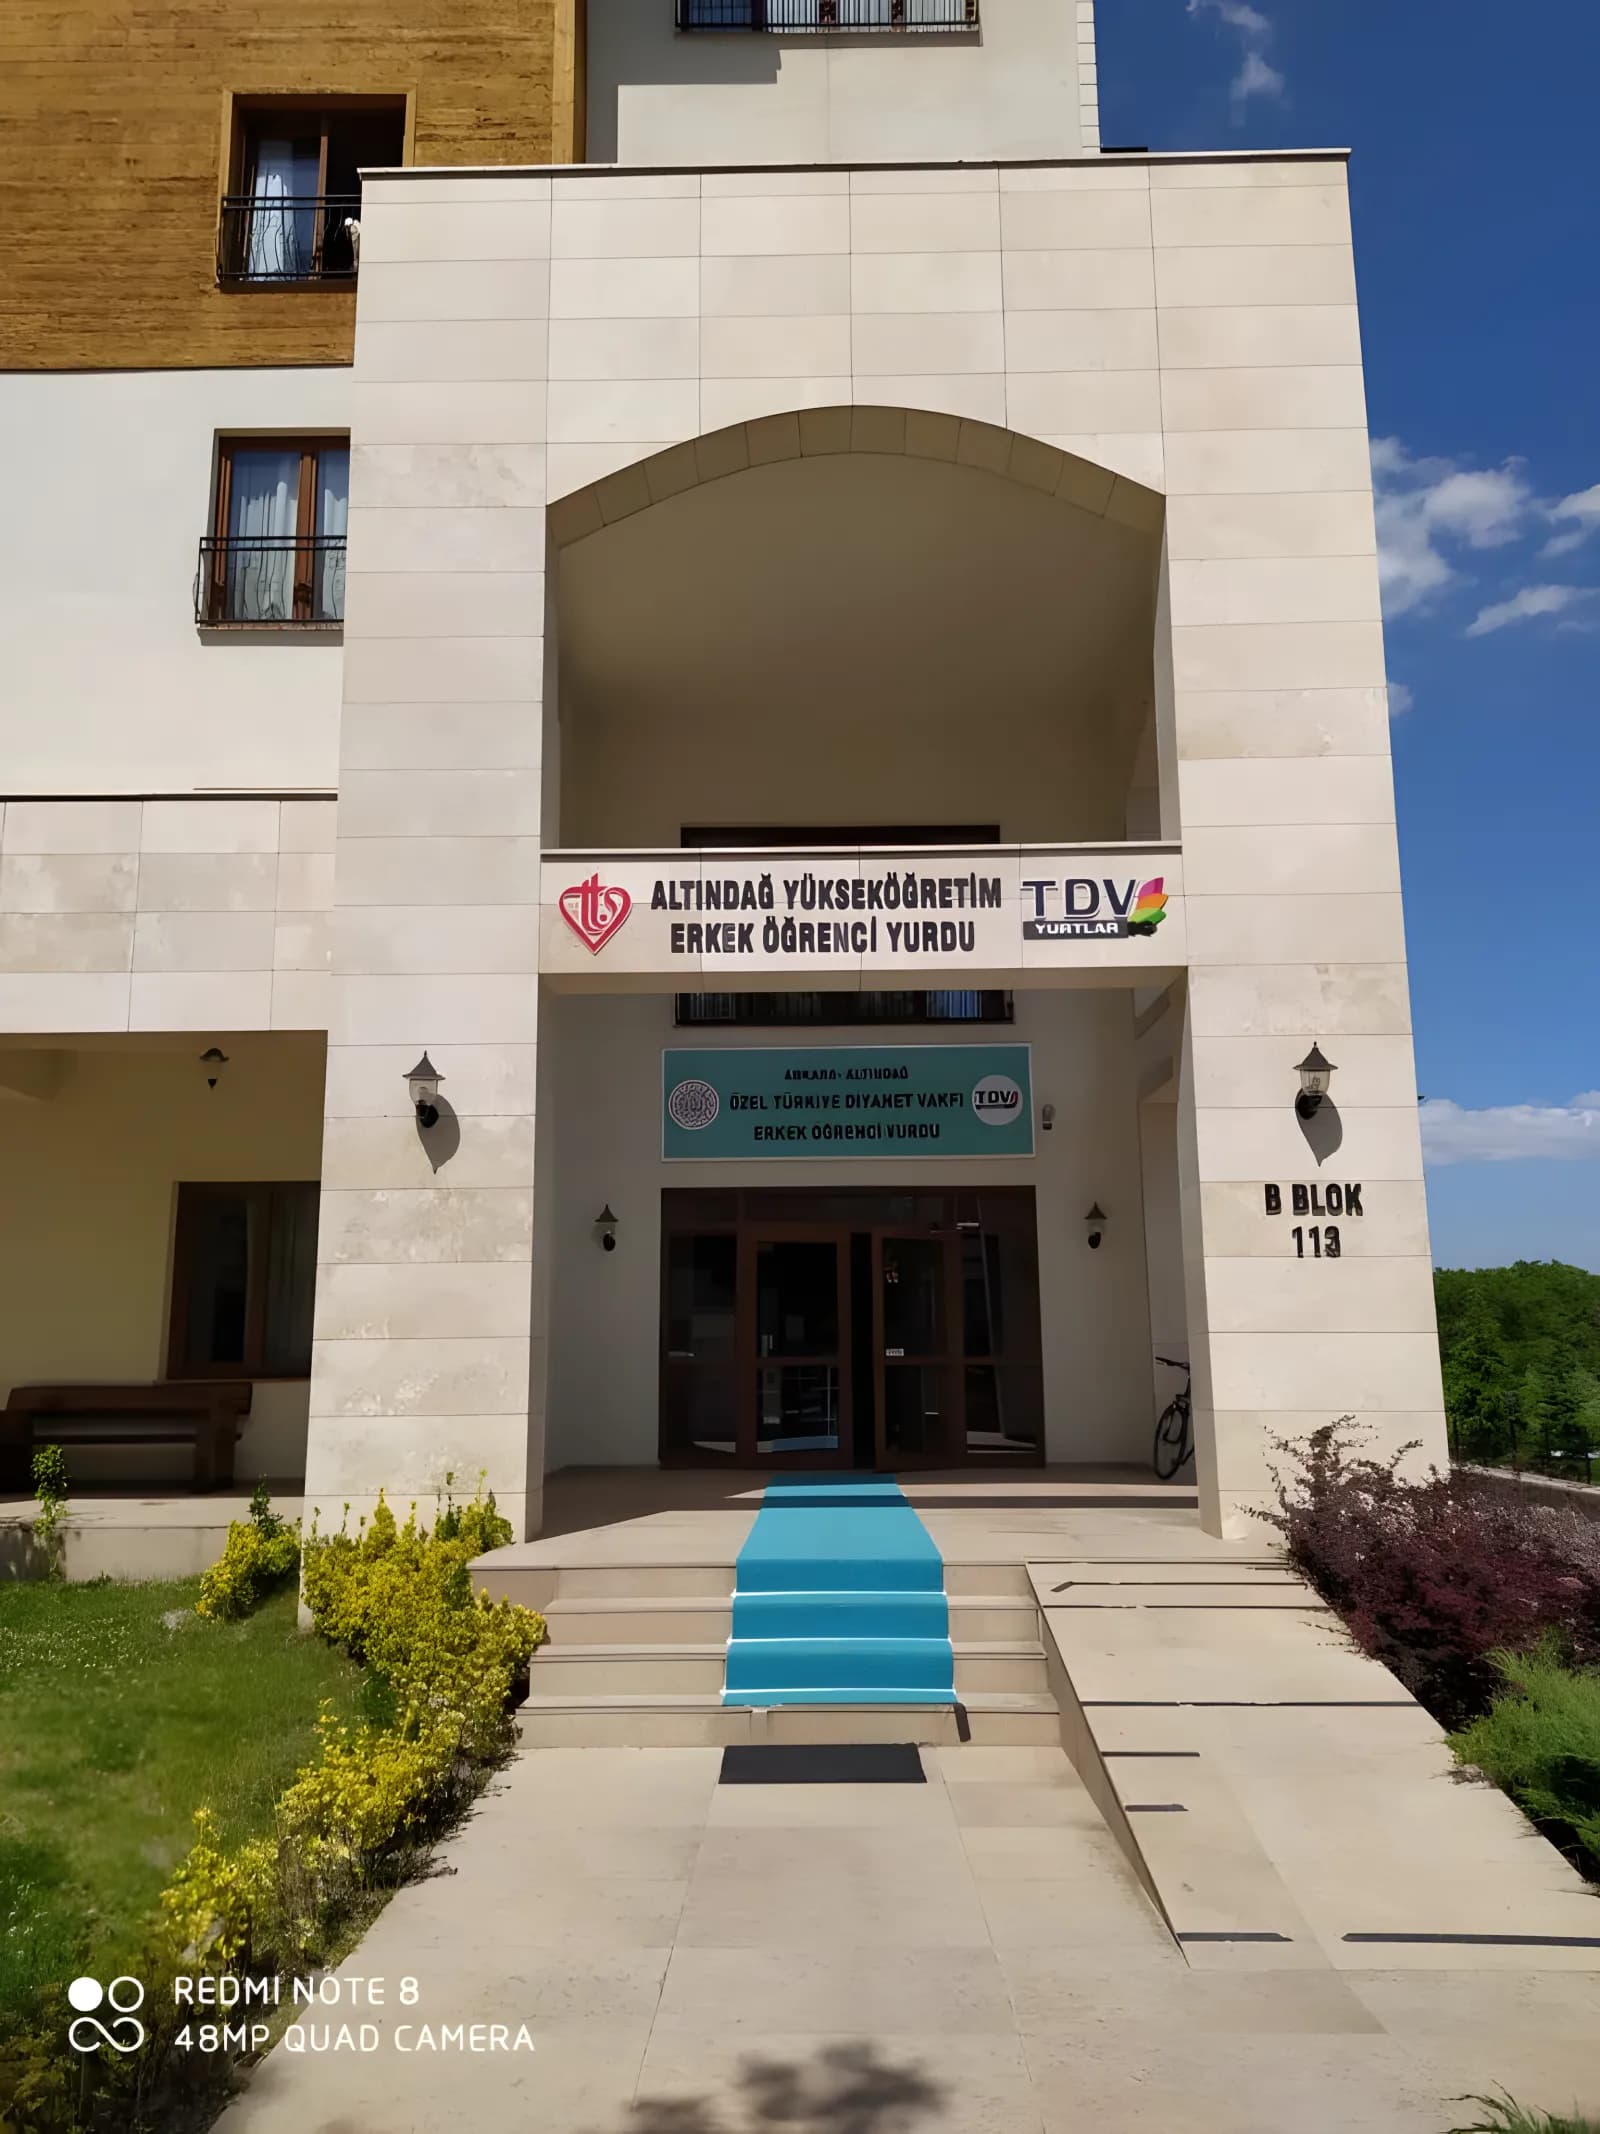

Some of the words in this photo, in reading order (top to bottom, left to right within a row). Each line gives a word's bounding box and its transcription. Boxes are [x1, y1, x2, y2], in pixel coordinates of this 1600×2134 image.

[651, 873, 774, 910] ALTINDAĞ
[783, 872, 1002, 910] YÜKSEKÖĞRETİM
[1021, 878, 1136, 919] TDV
[671, 922, 754, 953] ERKEK
[763, 915, 877, 953] ÖĞRENCİ
[886, 921, 975, 952] YURDU
[1034, 922, 1119, 935] YURTLAR
[730, 1091, 768, 1110] ÖZEL
[917, 1092, 964, 1108] VAKFI
[975, 1090, 1011, 1104] TDV
[754, 1125, 807, 1141] ERKEK
[1264, 1183, 1282, 1216] B
[1291, 1183, 1364, 1217] BLOK
[1291, 1226, 1341, 1258] 113
